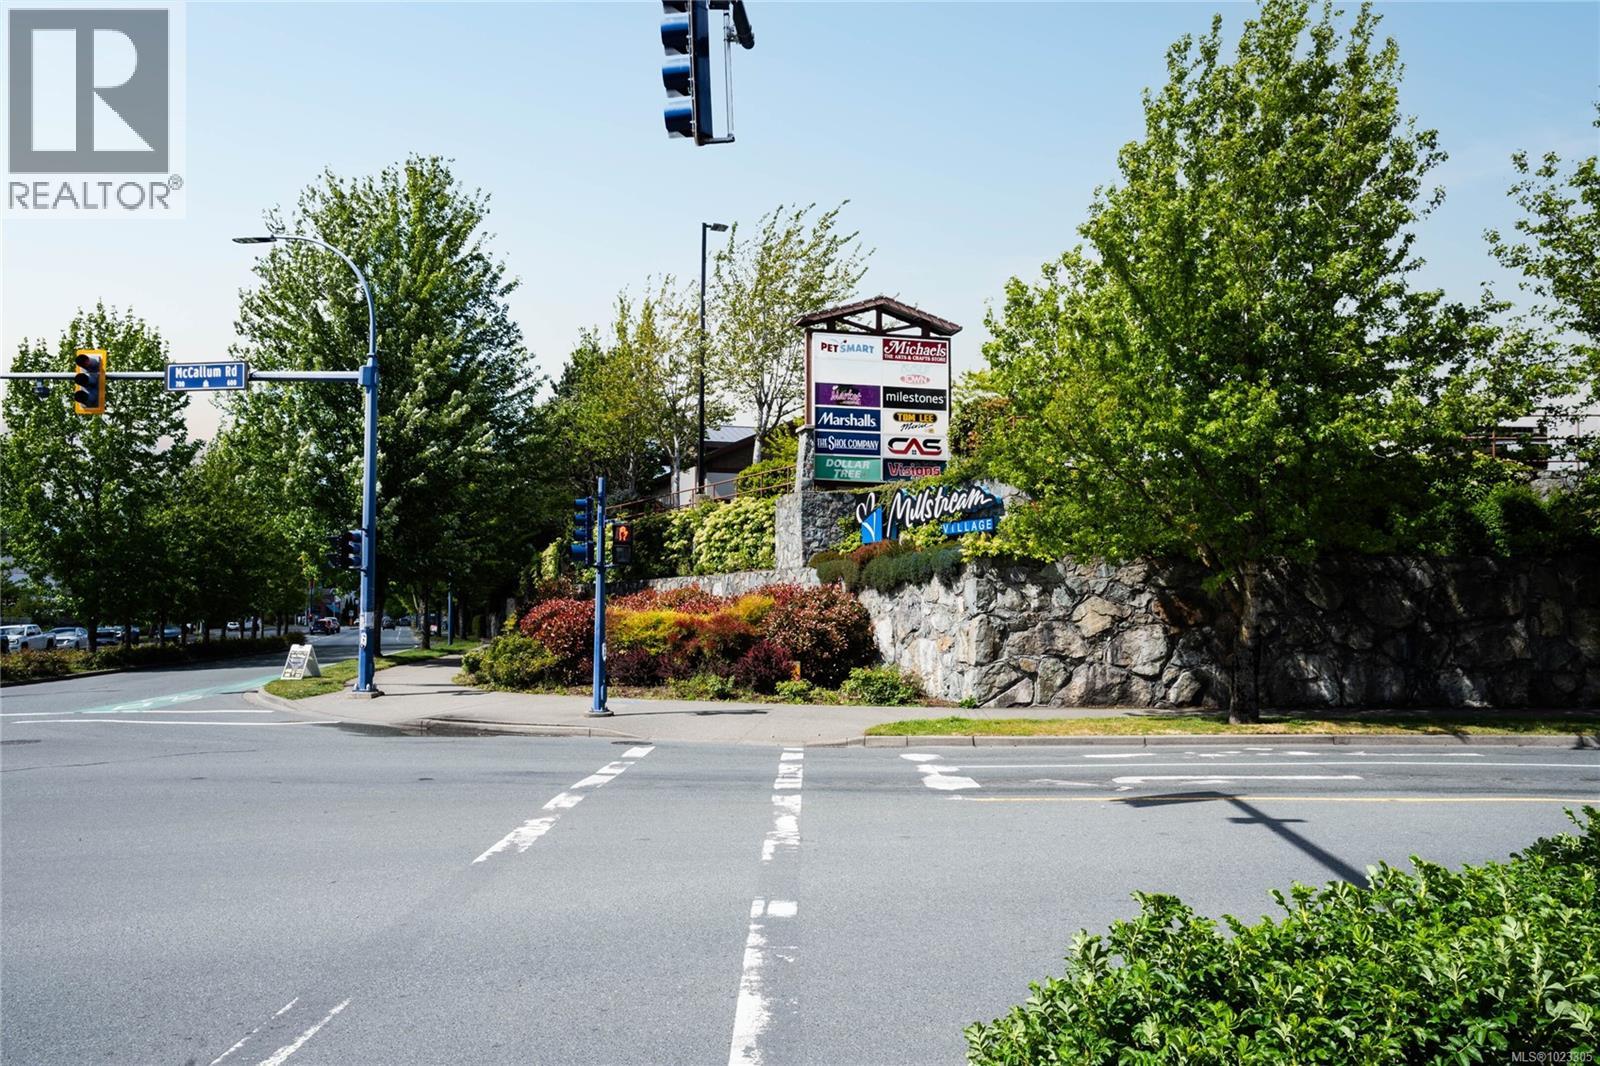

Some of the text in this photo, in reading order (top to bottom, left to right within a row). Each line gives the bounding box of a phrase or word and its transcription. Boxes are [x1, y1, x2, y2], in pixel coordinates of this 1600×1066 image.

[884, 340, 947, 357] Michaels
[175, 365, 237, 378] McCallum Rd
[885, 391, 945, 404] milestones
[817, 411, 877, 427] Marshalls
[897, 413, 934, 423] TOM LEE
[817, 437, 828, 448] THE
[847, 438, 879, 450] COMPANY
[887, 437, 942, 456] CAS
[825, 458, 870, 469] DOLLAR
[887, 462, 941, 477] Visions
[833, 468, 861, 479] TREE
[886, 487, 993, 539] Millstream
